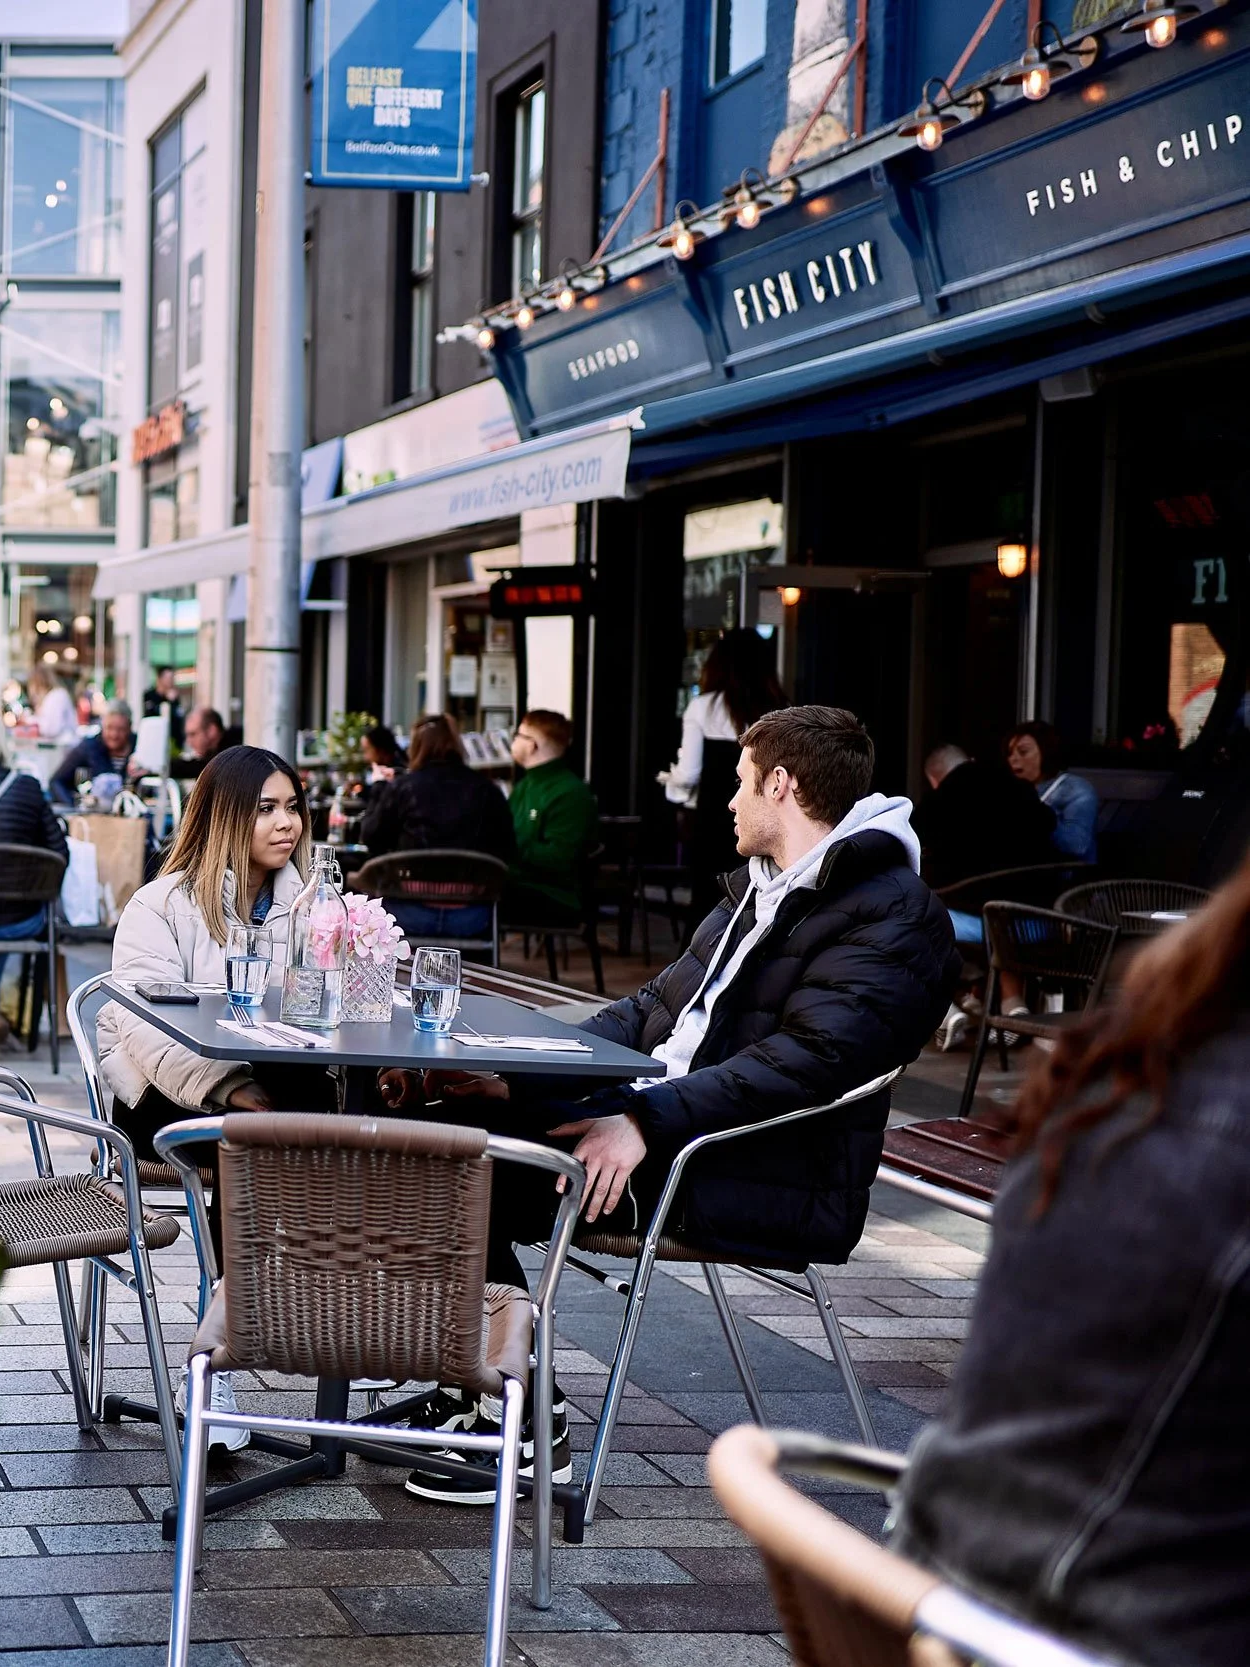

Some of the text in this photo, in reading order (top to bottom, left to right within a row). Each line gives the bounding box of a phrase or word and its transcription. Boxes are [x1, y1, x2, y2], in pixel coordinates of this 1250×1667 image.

[346, 66, 403, 87] BELFAST
[373, 106, 410, 127] DAYS
[374, 87, 444, 110] DIFFERENT
[1025, 169, 1098, 216] FISH
[1118, 155, 1135, 183] &
[733, 240, 877, 330] FISH CITY
[567, 339, 640, 382] SEAFOOD
[449, 455, 603, 514] www.fish-city.com
